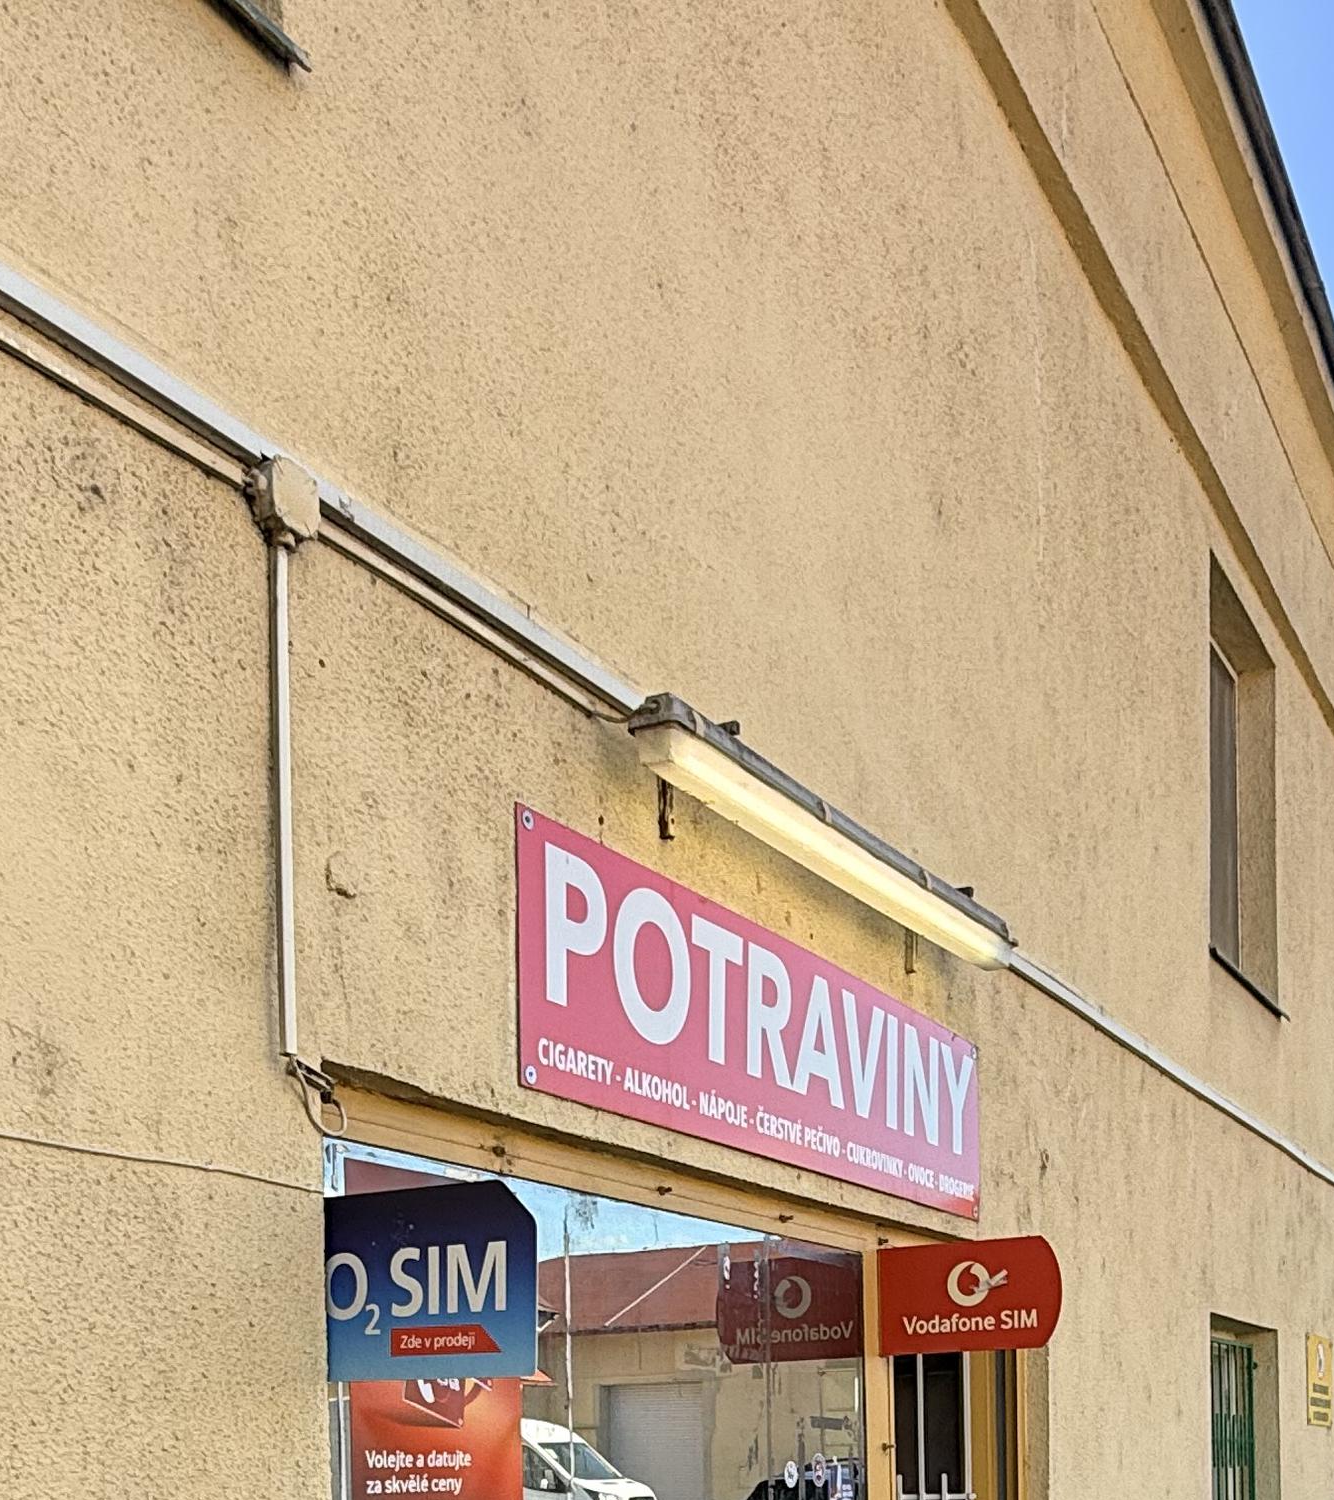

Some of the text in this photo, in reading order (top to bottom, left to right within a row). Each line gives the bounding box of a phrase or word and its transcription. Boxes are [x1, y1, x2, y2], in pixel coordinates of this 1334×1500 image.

[544, 841, 975, 1155] POTRAVINY
[538, 1037, 614, 1085] CIGARETY
[623, 1067, 690, 1110] ALKOHOL
[699, 1089, 748, 1128] NÁPOJE
[756, 1105, 803, 1145] ČERSTVÉ
[804, 1125, 840, 1157] PEČIVO
[847, 1141, 903, 1179] CUKROVINKY
[908, 1163, 934, 1189] OVOCE
[390, 1240, 507, 1318] SIM
[903, 1309, 1038, 1336] Vodafone SIM
[400, 1331, 475, 1350] Zde v prodeji
[365, 1449, 472, 1472] Volejte a datujte
[366, 1473, 463, 1495] za skvělé ceny
